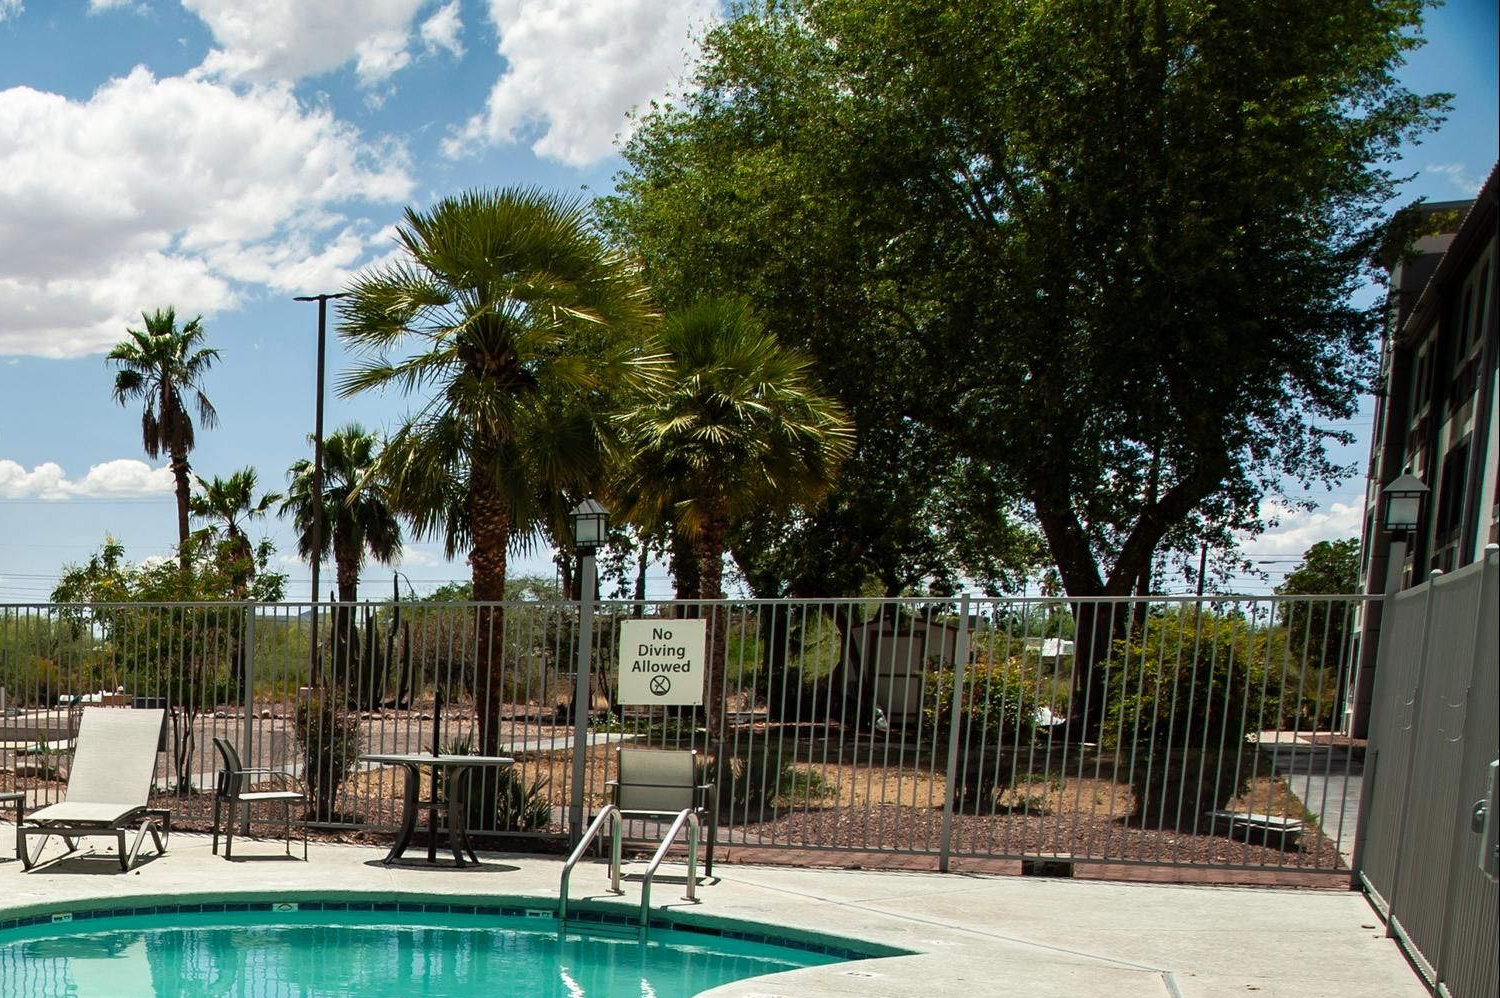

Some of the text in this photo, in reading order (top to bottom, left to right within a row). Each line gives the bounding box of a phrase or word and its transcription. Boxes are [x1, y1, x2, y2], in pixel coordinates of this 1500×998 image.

[652, 628, 672, 640] No
[638, 644, 685, 659] Diving
[632, 660, 690, 672] Allowed
